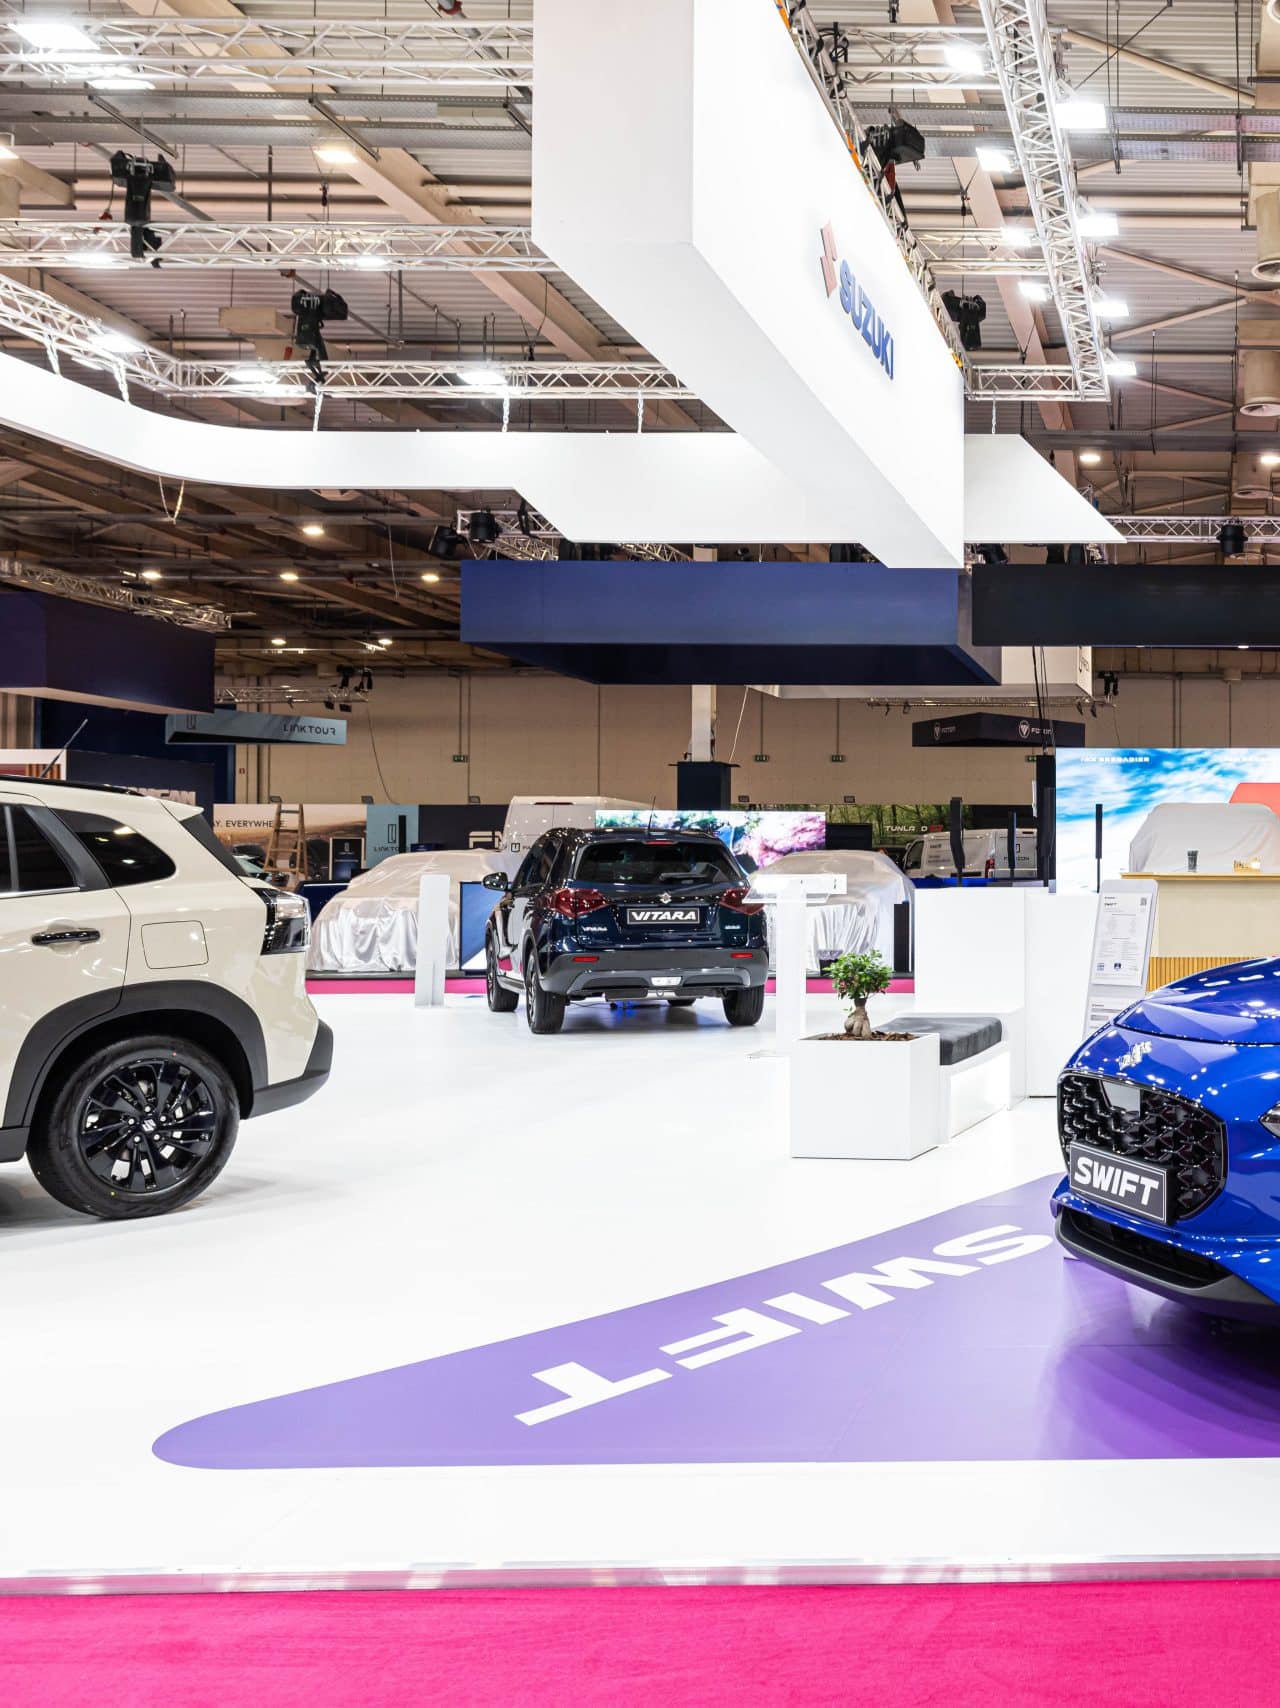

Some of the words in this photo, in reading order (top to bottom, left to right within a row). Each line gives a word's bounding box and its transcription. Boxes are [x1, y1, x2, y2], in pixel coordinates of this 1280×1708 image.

[839, 259, 894, 380] SUZUKI
[225, 820, 287, 828] EVERYWHEE
[631, 911, 697, 921] VITARA
[1074, 1157, 1159, 1206] SWIFT
[513, 1224, 1054, 1426] SWIFT
